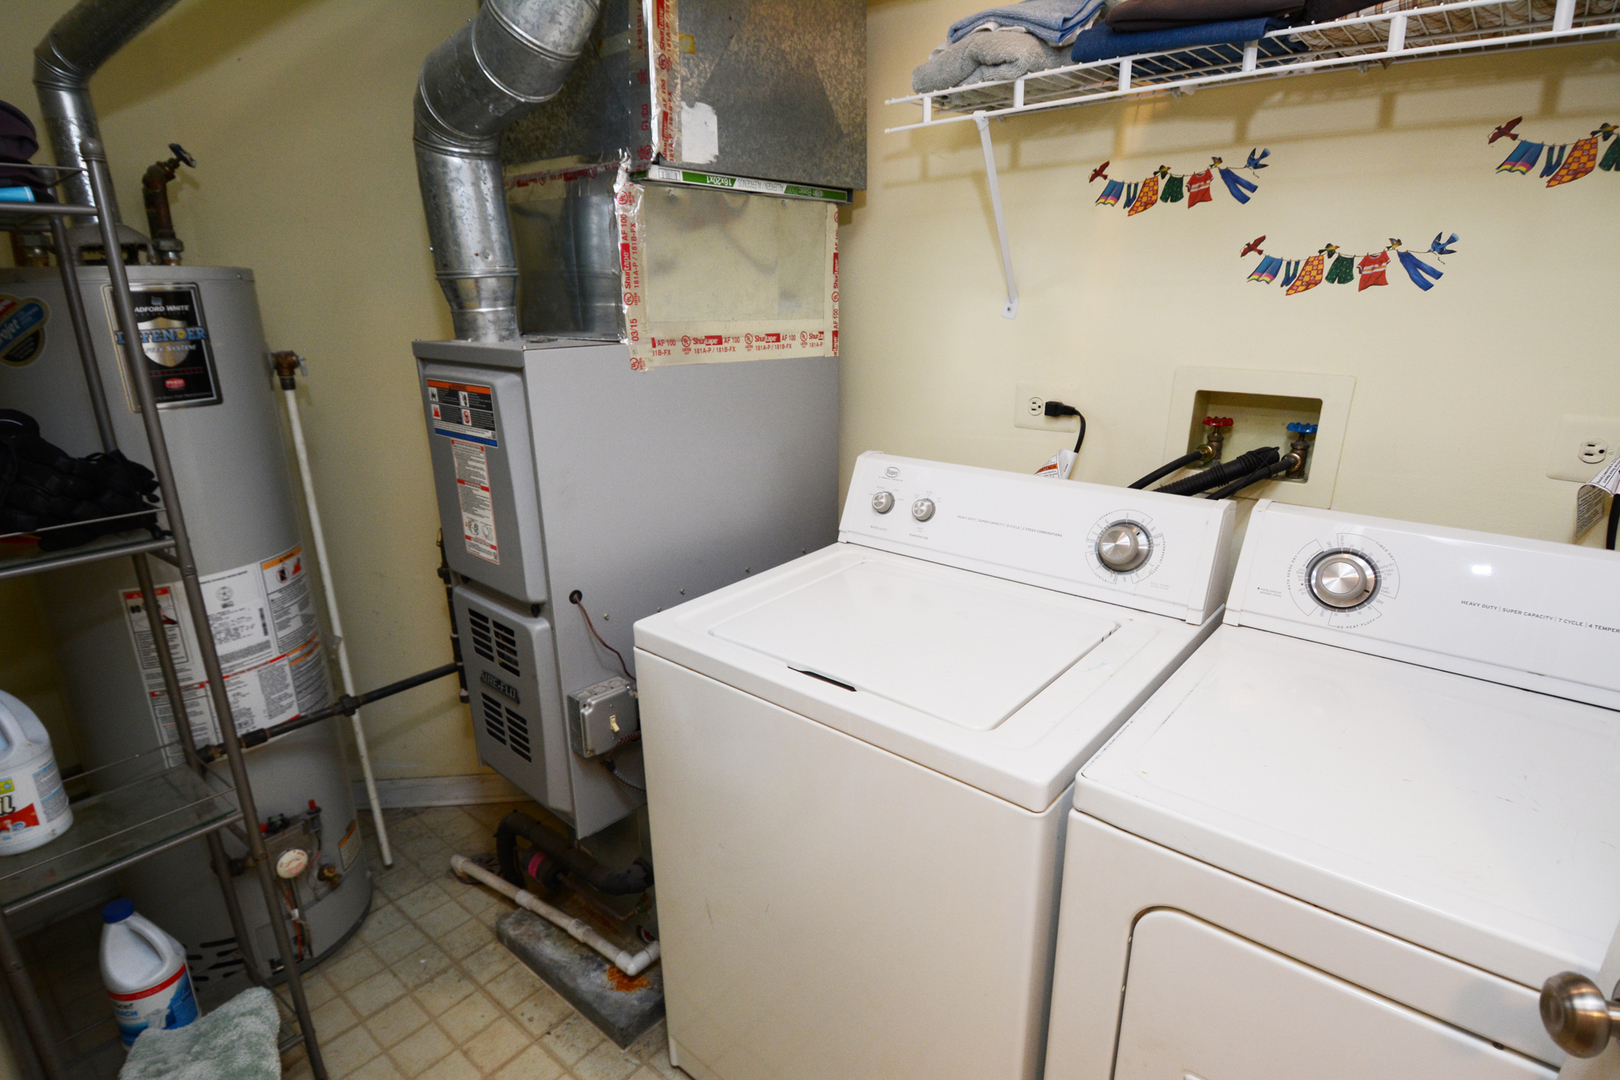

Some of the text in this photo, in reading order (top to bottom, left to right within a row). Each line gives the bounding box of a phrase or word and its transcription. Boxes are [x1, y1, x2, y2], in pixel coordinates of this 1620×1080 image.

[641, 104, 649, 130] 03/15
[706, 174, 733, 188] 16x20x1
[630, 223, 638, 255] 181B-FX
[620, 214, 632, 289] Shurtape AF 100
[629, 318, 639, 341] 03/15
[754, 335, 778, 343] Shurtape
[781, 334, 788, 342] AF
[657, 338, 676, 347] AF 100
[692, 336, 740, 346] Shurtape AF 100
[693, 347, 712, 355] 181A-P
[1461, 600, 1480, 608] HEAVY
[1482, 603, 1498, 611] DUTY
[1502, 607, 1522, 615] SUPER
[1523, 611, 1553, 621] CAPACITY
[1563, 618, 1583, 627] CYCLE
